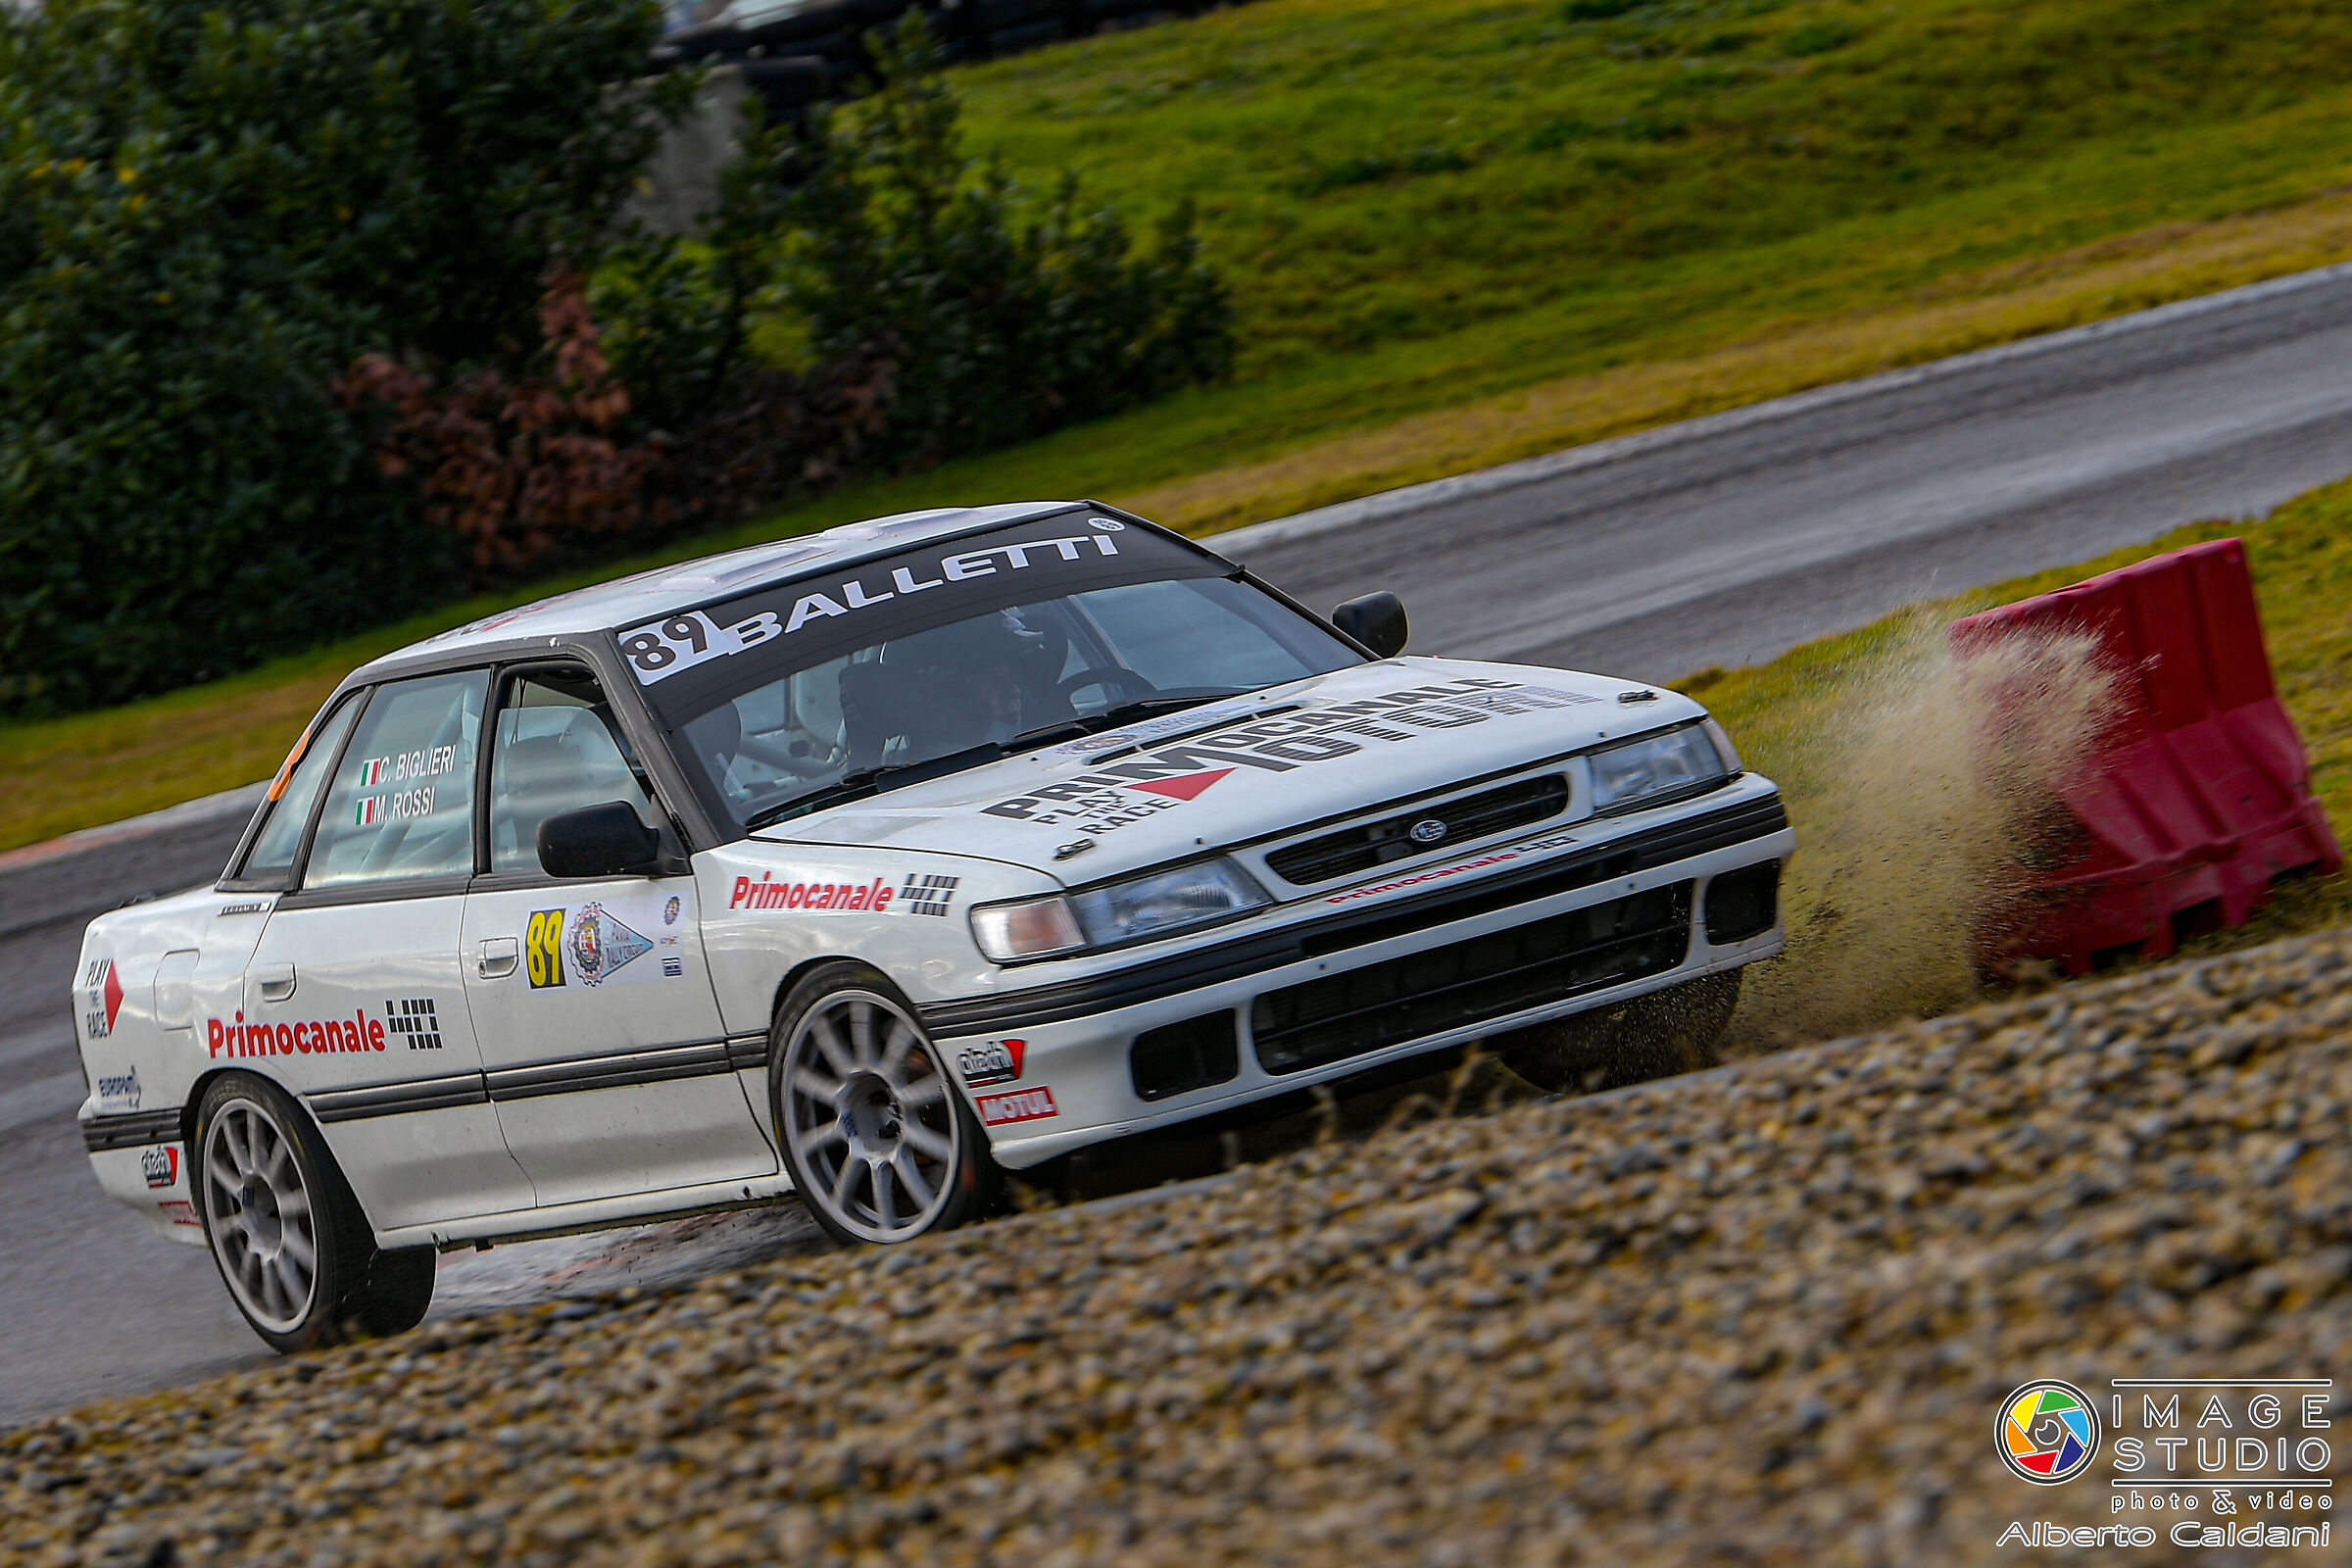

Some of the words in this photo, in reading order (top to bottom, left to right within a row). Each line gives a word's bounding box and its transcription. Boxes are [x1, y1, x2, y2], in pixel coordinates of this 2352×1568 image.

[622, 614, 709, 671] 89
[727, 534, 1119, 656] BALLETTI
[378, 758, 391, 782] C.
[395, 744, 457, 781] BIGLIERI
[980, 677, 1525, 819] PRIMOCANALE
[373, 795, 388, 823] M.
[392, 786, 436, 820] ROSSI
[1031, 789, 1125, 825] PLAY
[1075, 798, 1181, 835] RACE
[729, 870, 894, 912] Primocanale
[526, 909, 564, 988] 89
[85, 956, 112, 988] PLAY
[207, 1008, 386, 1059] Primocanale
[980, 1090, 1055, 1122] MOTUL
